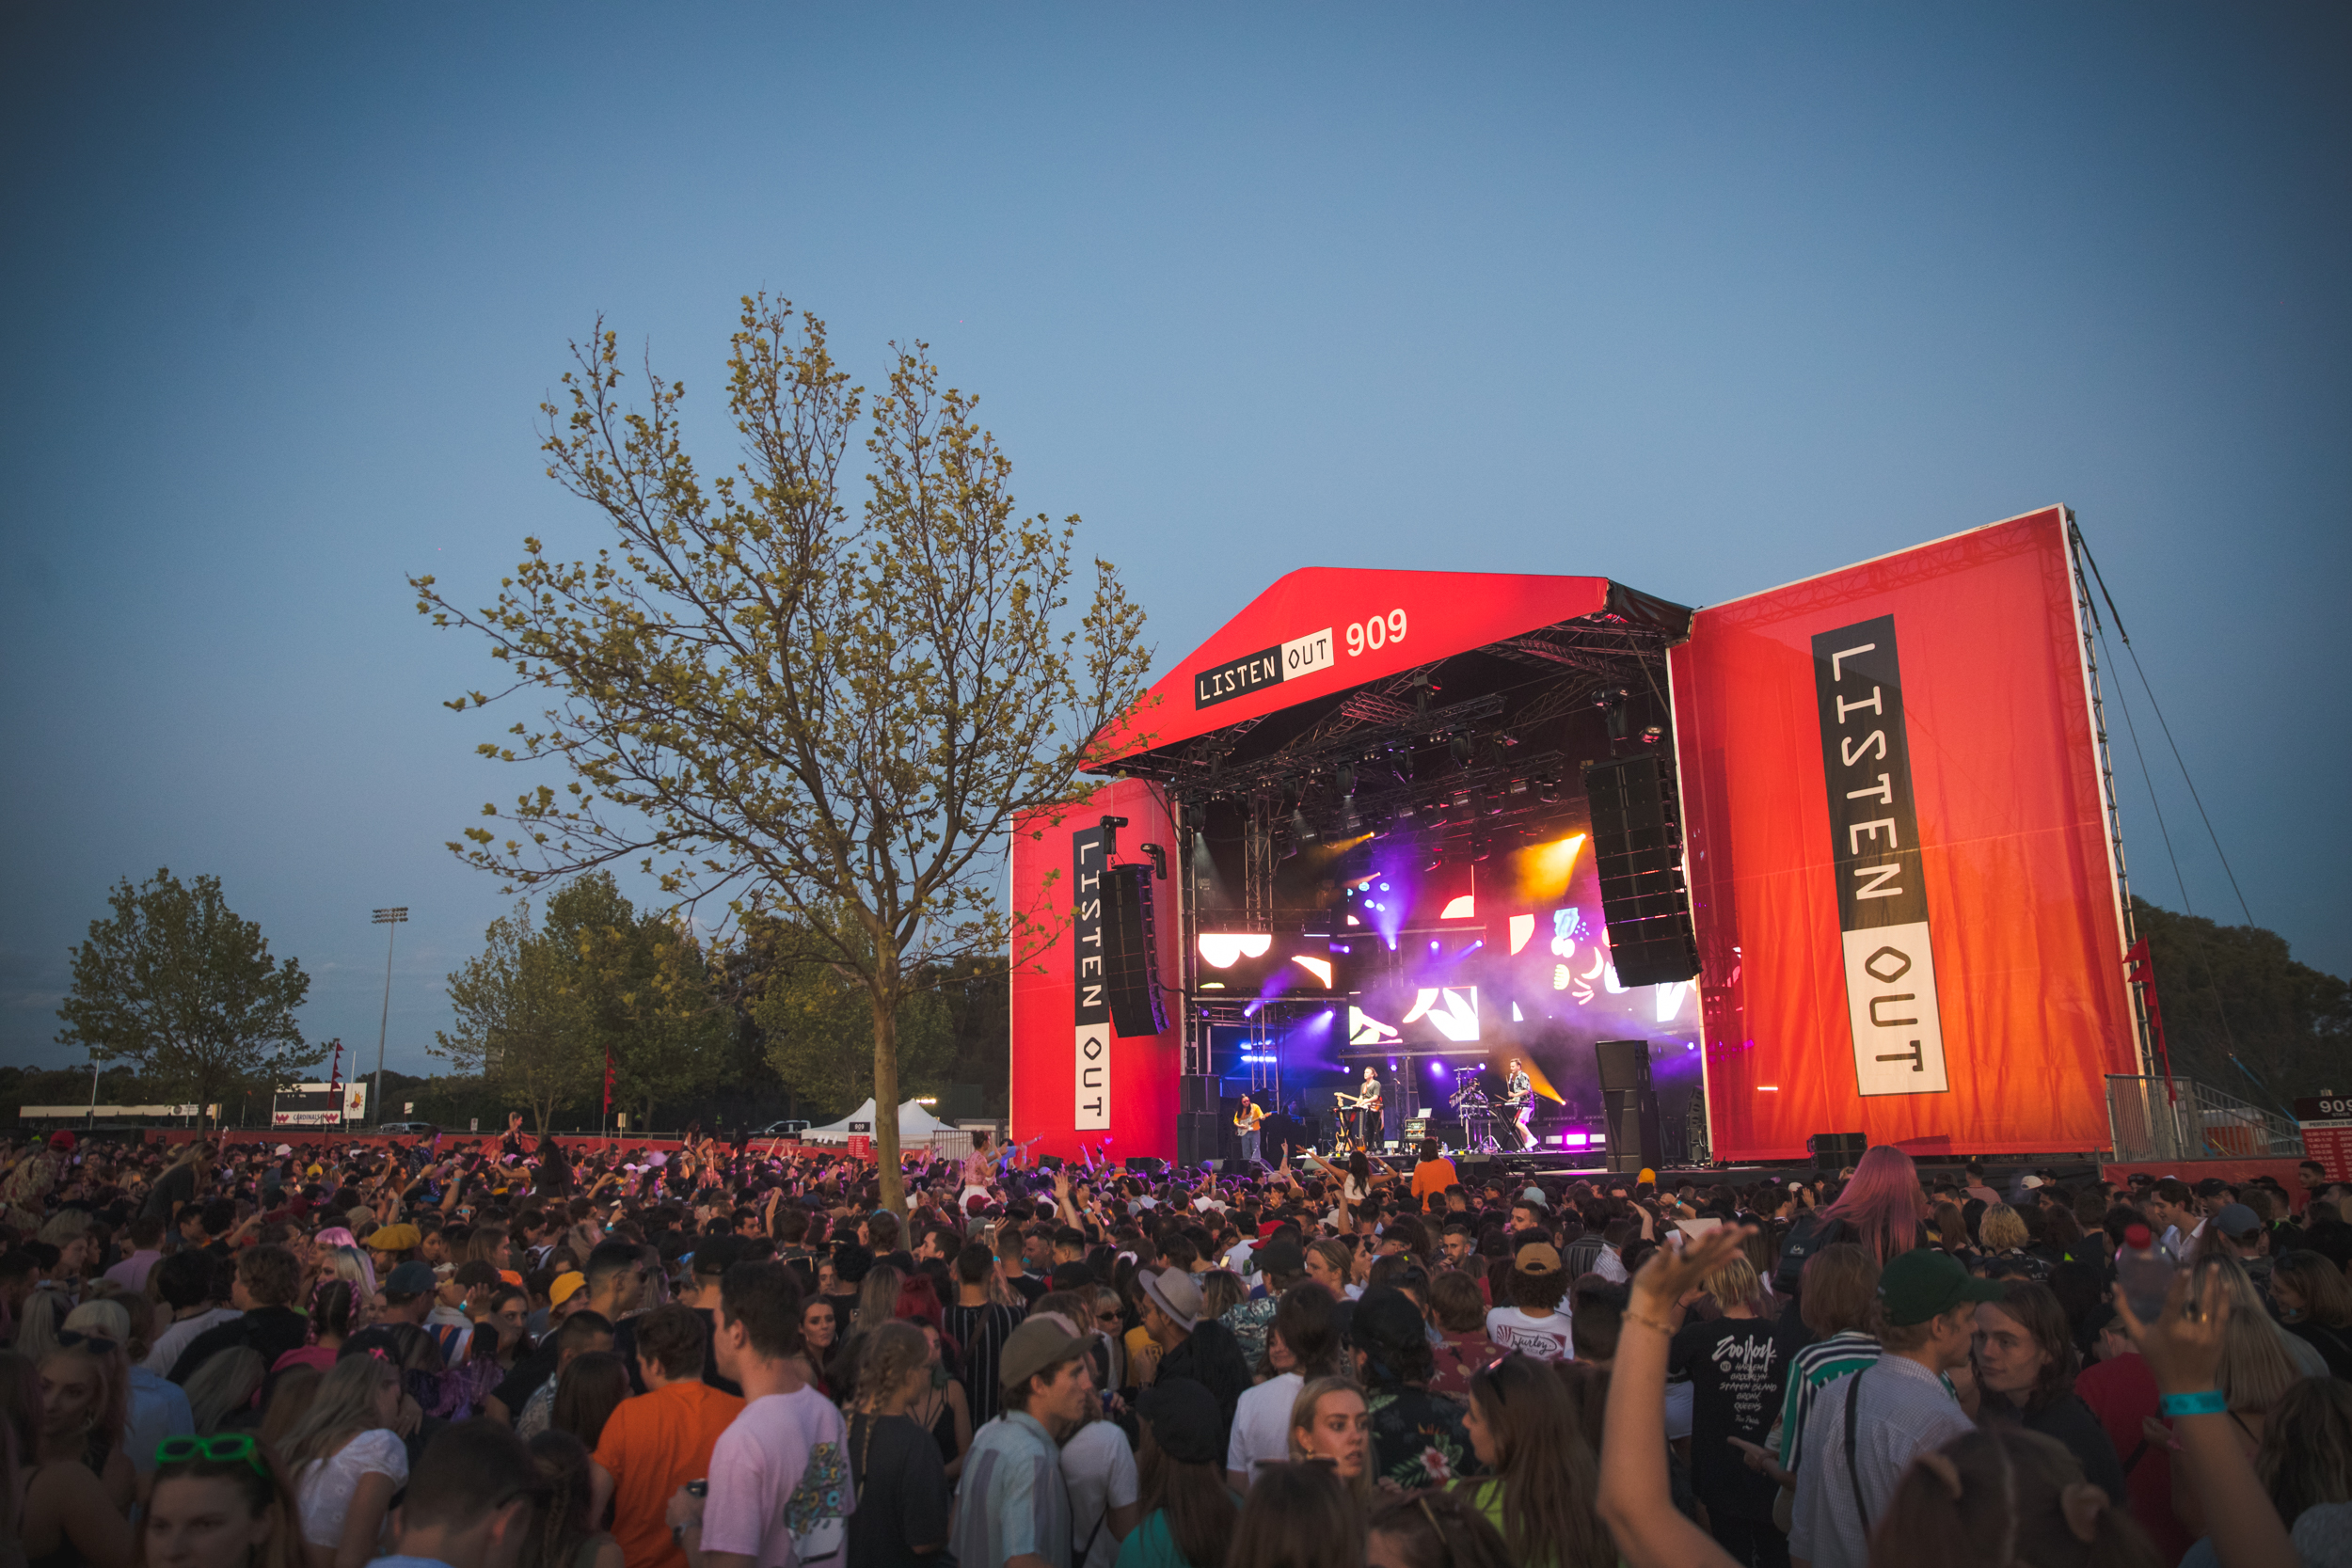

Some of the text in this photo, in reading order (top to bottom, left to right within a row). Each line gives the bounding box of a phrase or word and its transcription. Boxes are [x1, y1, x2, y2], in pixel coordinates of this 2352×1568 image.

[1200, 609, 1407, 701] LISTEN OUT 909
[1831, 642, 1924, 1072] LISTEN OUT
[1080, 841, 1103, 1117] LISTEN OUT
[1735, 1362, 1764, 1371] HARLEM
[1730, 1372, 1767, 1382] BROOKLYN
[1719, 1382, 1777, 1392] STATEN ISLAND
[1736, 1391, 1762, 1402] BRONX
[1733, 1402, 1762, 1412] QUEENS
